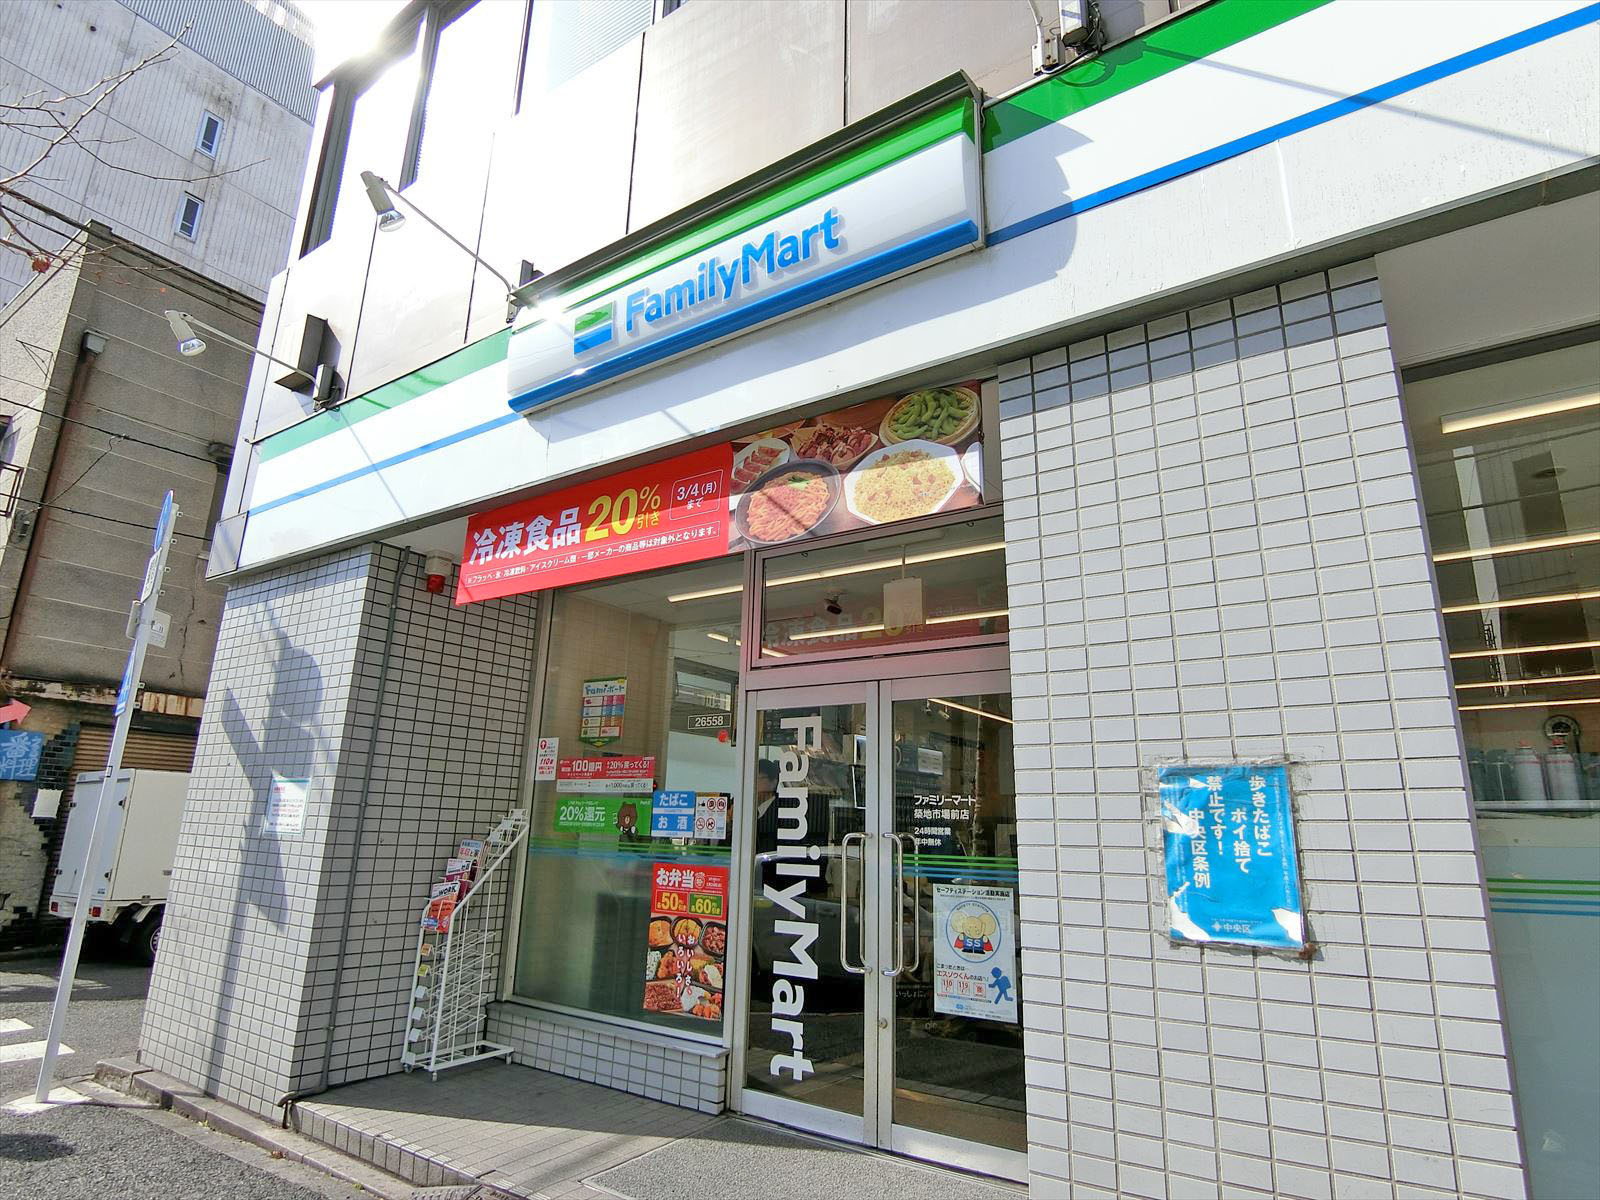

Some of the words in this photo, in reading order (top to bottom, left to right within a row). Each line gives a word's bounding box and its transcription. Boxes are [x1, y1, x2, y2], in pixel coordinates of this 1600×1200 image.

[626, 209, 840, 333] FamilyMart
[686, 497, 704, 510] まで
[469, 507, 581, 566] 冷凍食品
[585, 484, 660, 542] 20%
[637, 511, 660, 529] 引き
[695, 716, 724, 727] 26558
[660, 793, 688, 806] たばこ
[914, 795, 976, 806] ファミリーマート
[560, 806, 605, 822] 20%還元
[914, 809, 970, 820] 築地市場前店
[1249, 775, 1272, 857] 歩きたばこ
[1231, 807, 1251, 873] ポイ捨て
[656, 868, 694, 889] お弁当
[764, 716, 823, 1081] FamilyMart
